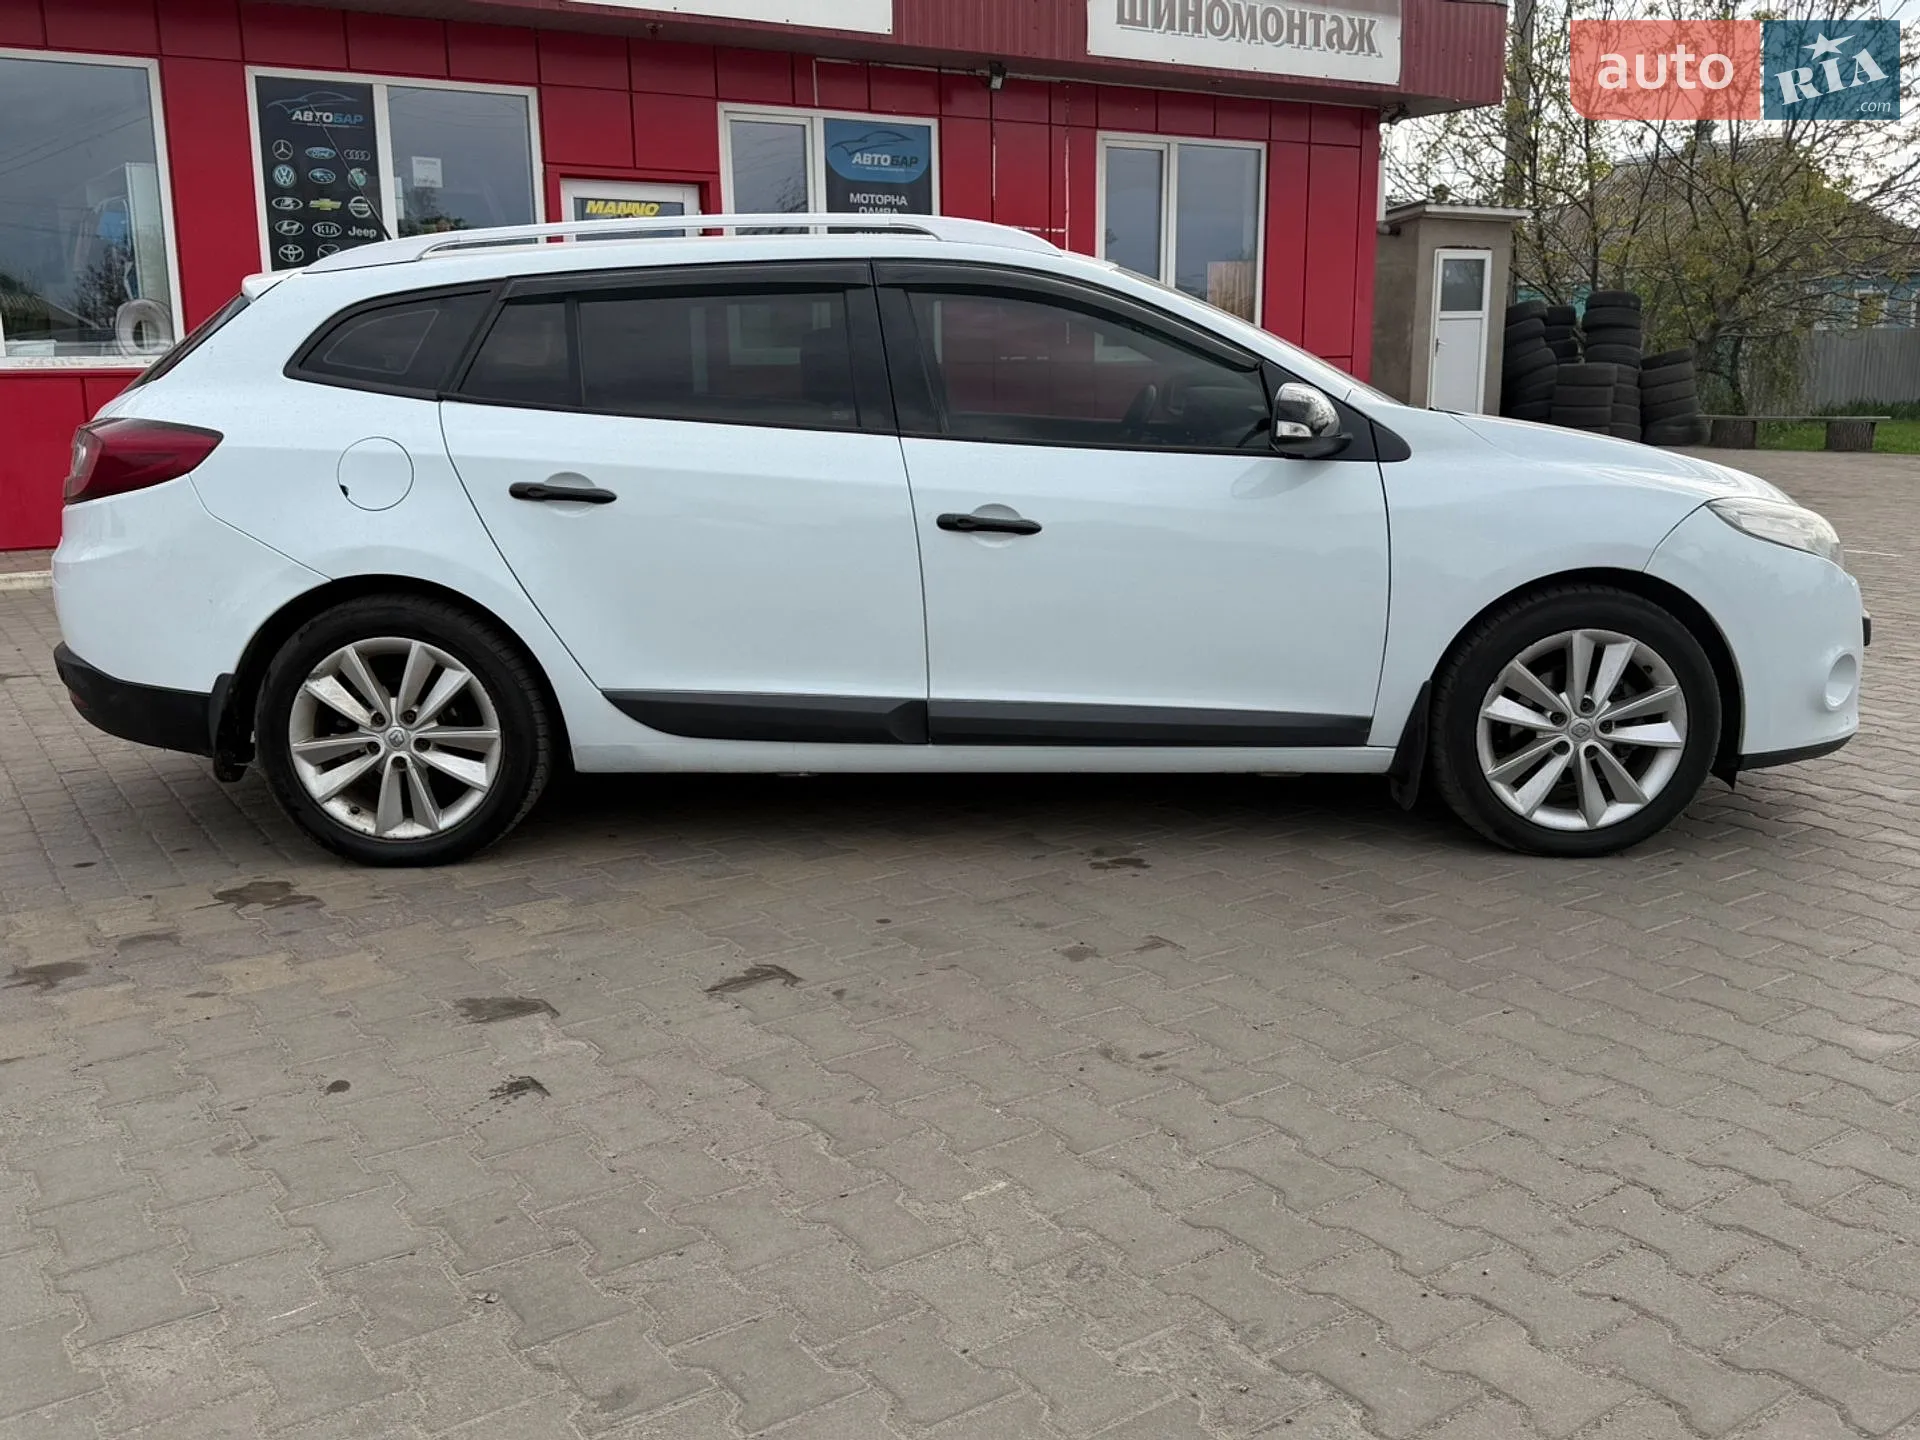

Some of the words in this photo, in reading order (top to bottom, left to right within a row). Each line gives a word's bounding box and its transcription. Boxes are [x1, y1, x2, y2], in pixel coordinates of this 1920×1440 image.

[849, 192, 908, 206] МОТОРНА
[317, 225, 338, 234] KIA
[348, 226, 376, 238] Jeep
